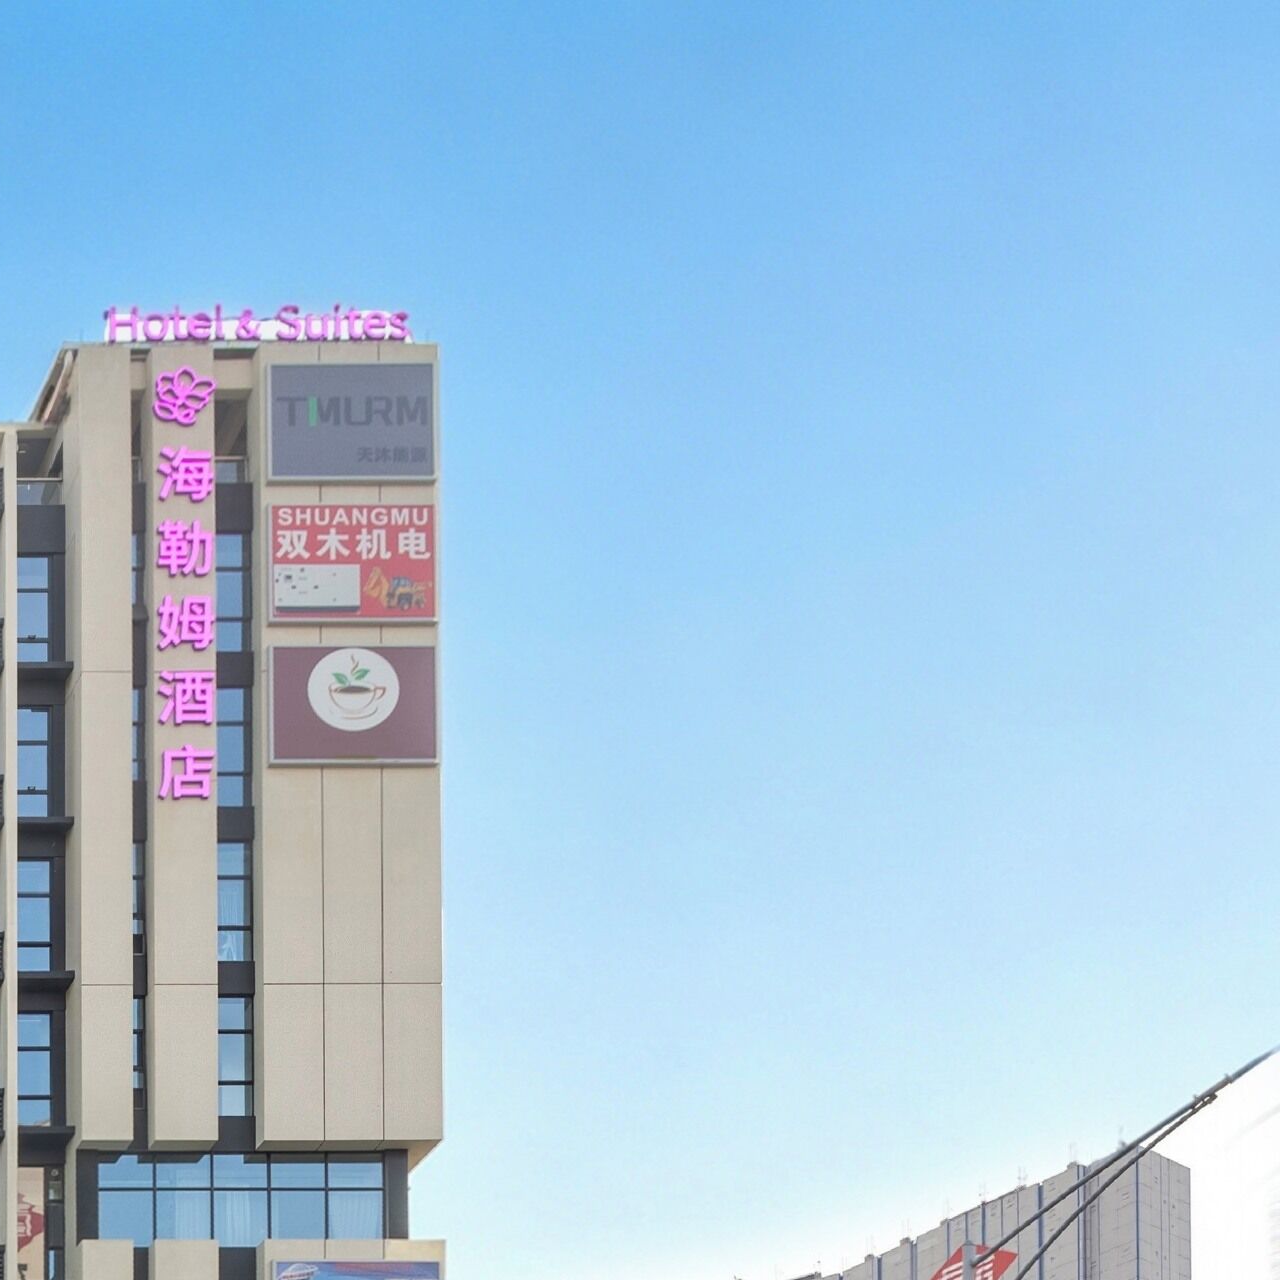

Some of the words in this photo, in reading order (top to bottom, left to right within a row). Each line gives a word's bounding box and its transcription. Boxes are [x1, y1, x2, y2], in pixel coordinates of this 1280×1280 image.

[107, 304, 224, 342] Hotel
[235, 309, 261, 340] &
[276, 304, 409, 341] Suites
[278, 508, 429, 527] SHUANGMU
[276, 528, 431, 560] 双木机电
[156, 445, 216, 800] 海勒姆酒店
